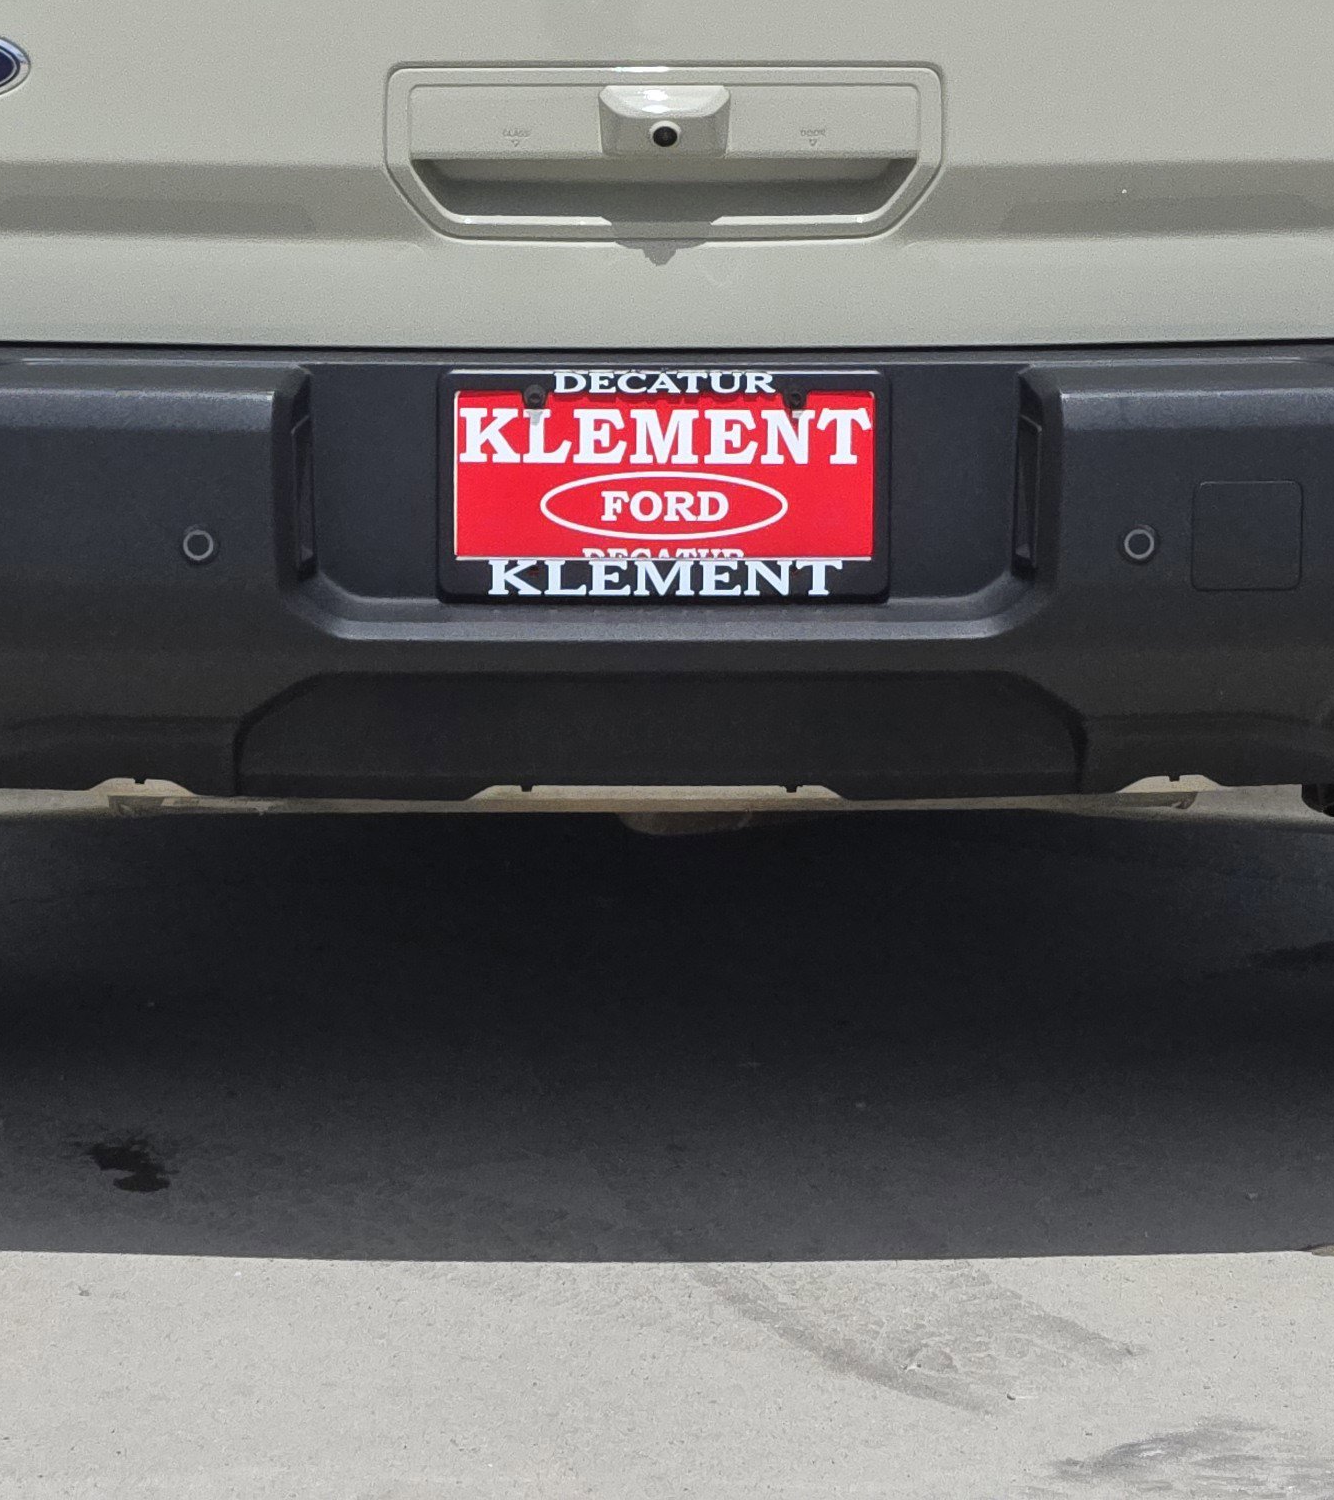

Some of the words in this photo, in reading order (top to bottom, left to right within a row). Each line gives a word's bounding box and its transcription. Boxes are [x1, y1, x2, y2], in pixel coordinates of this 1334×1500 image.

[553, 371, 777, 395] DECATUR
[458, 406, 874, 466] KLEMENT
[600, 490, 730, 523] FORD
[487, 558, 844, 597] KLEMENT
